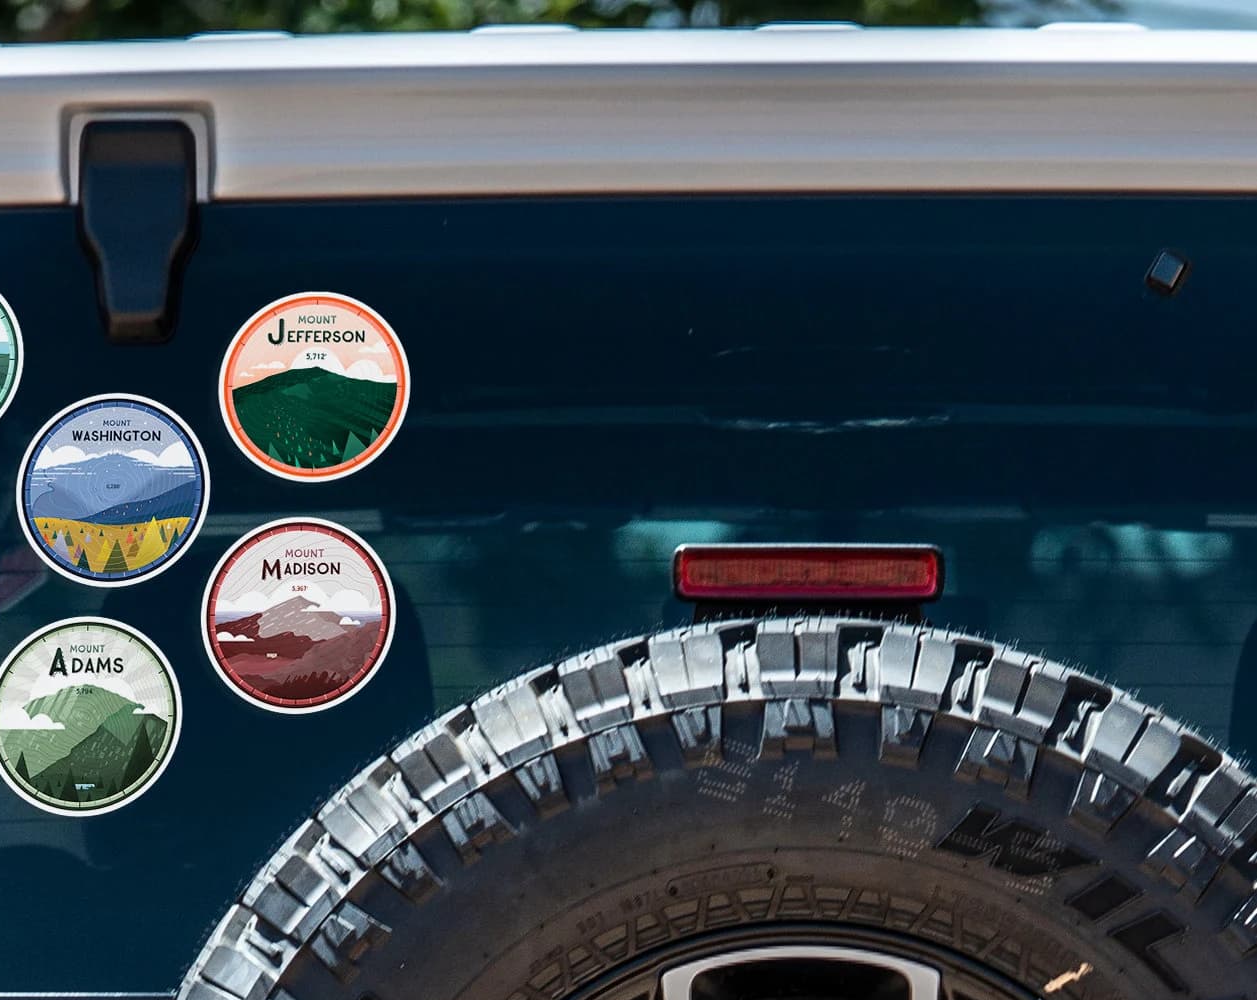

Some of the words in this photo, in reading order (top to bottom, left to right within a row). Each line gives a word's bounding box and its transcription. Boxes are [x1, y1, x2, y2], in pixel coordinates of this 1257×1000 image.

[298, 315, 337, 324] MOUNT
[268, 318, 365, 345] JEFFERSON
[72, 430, 161, 442] WASHINGTON
[285, 549, 325, 558] MOUNT
[262, 559, 341, 580] MADISON
[69, 644, 105, 653] MOUNT
[48, 647, 124, 676] ADAMS
